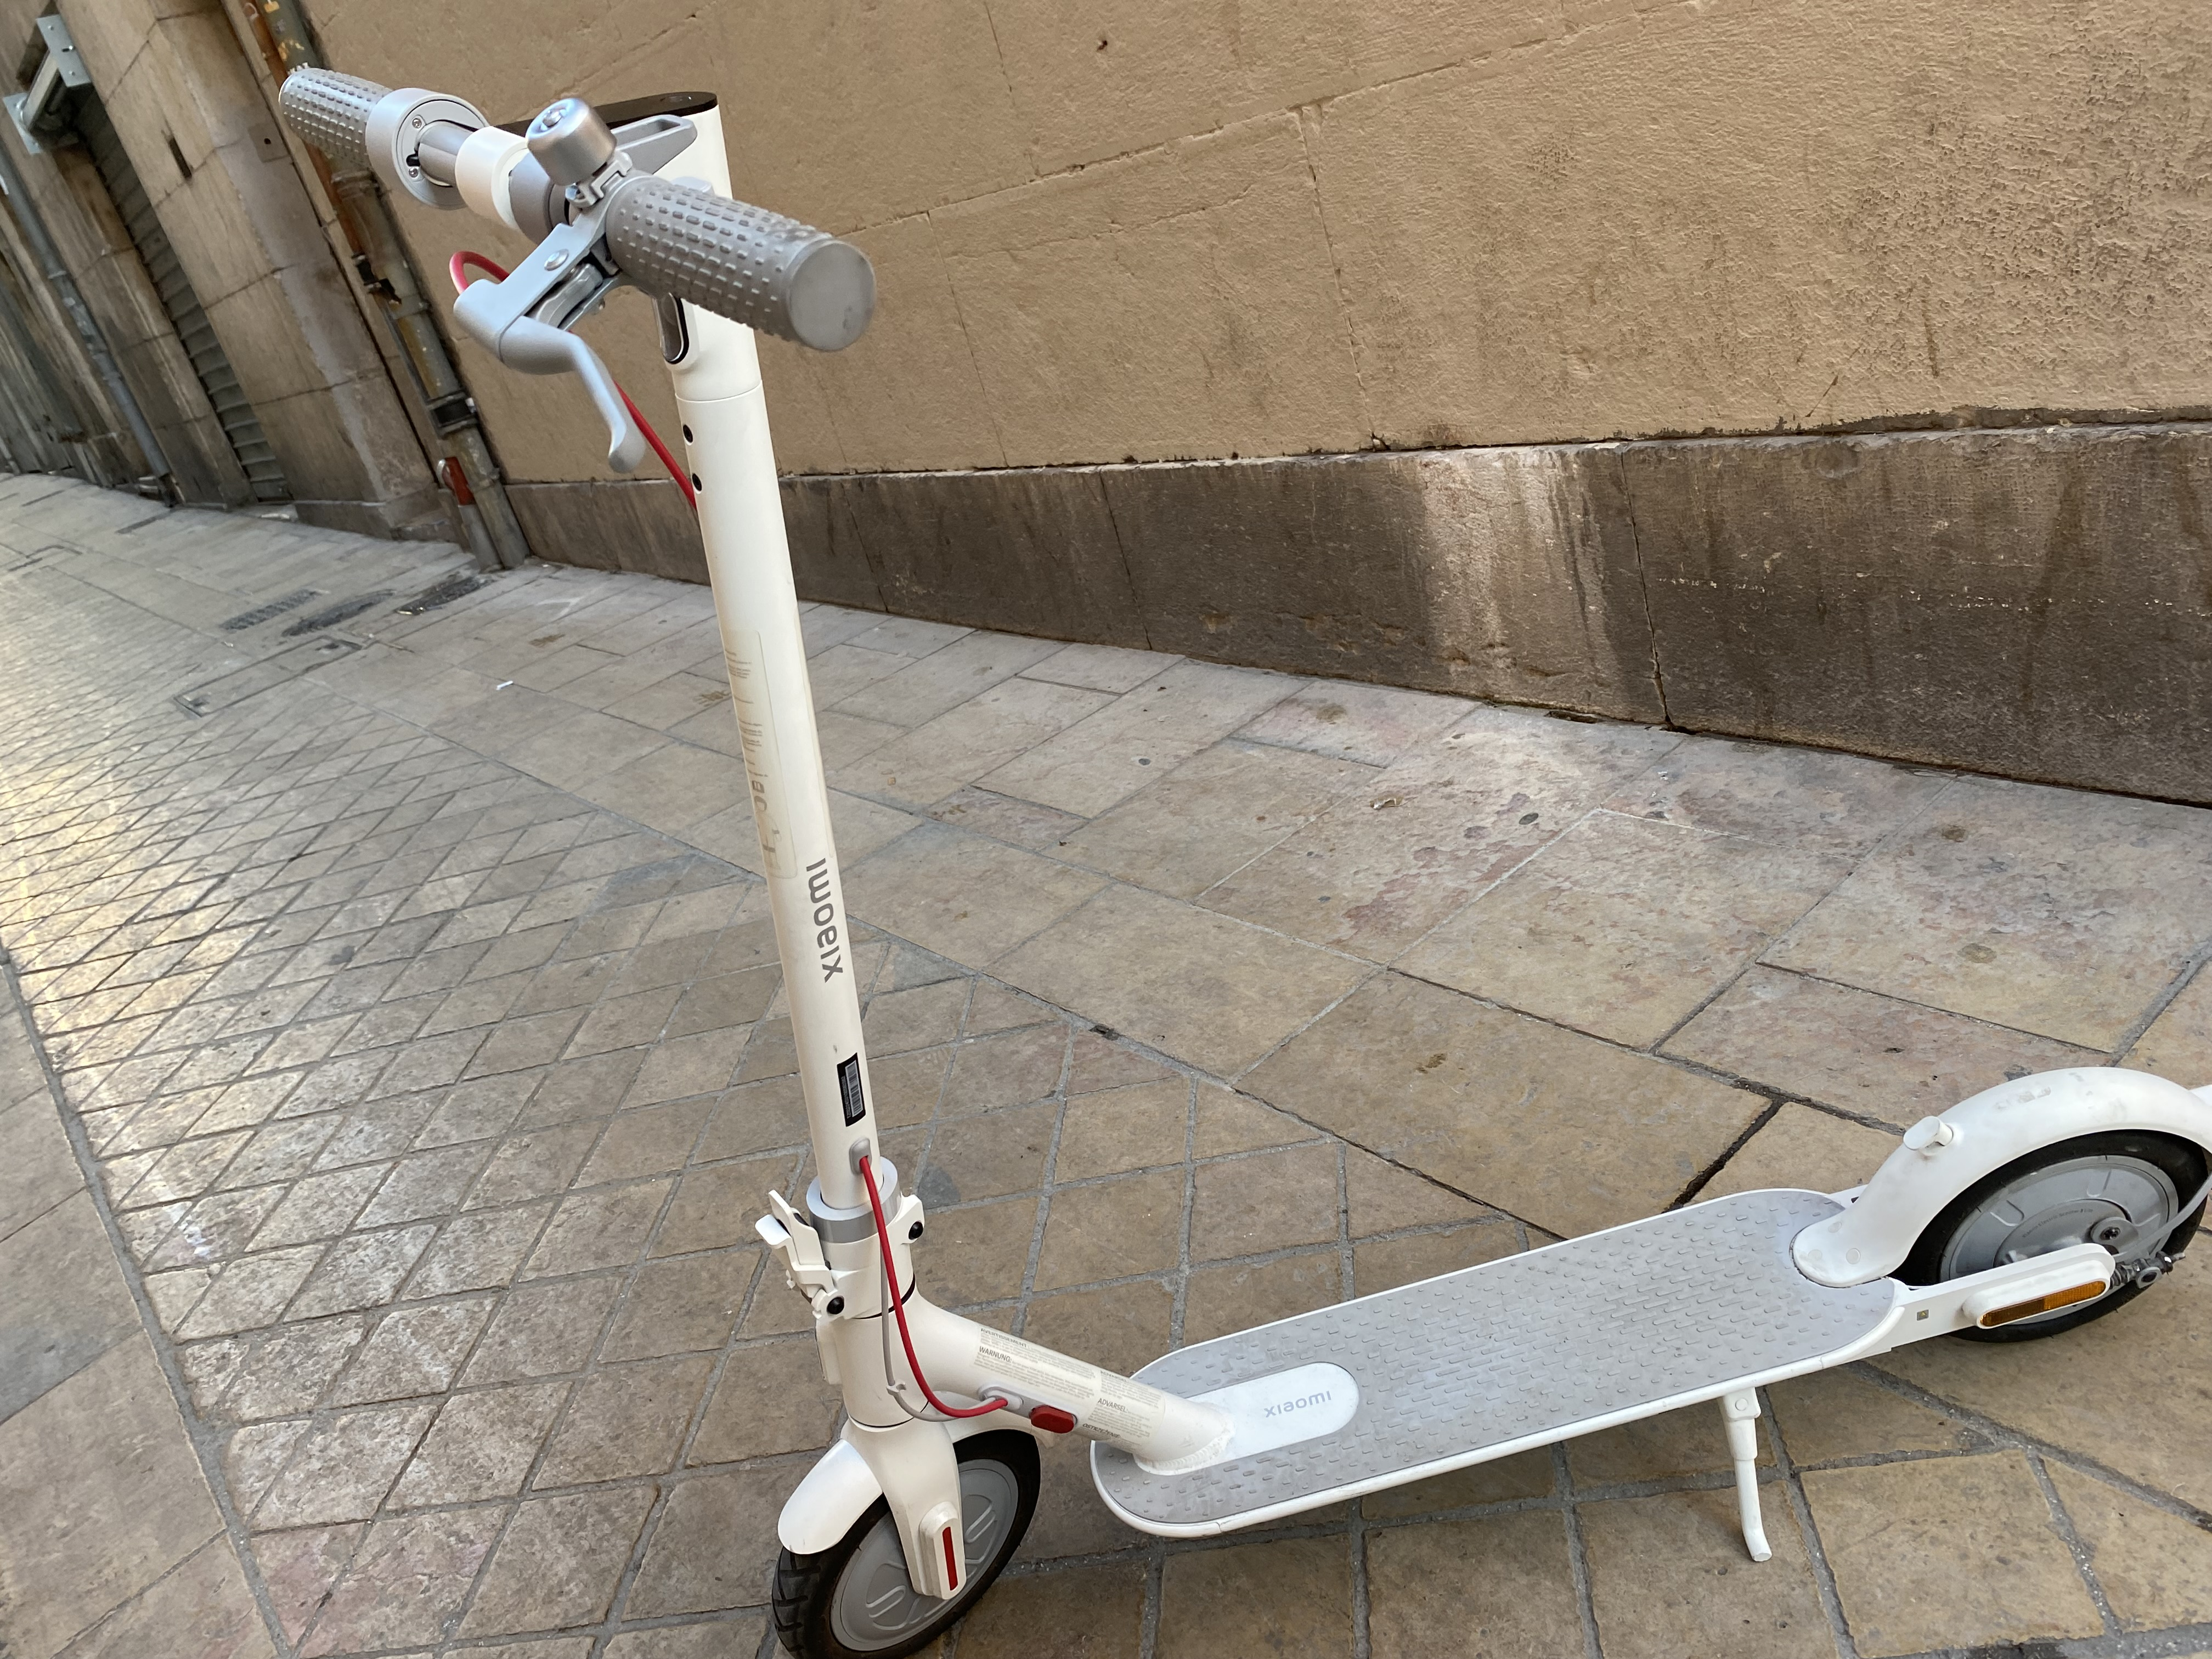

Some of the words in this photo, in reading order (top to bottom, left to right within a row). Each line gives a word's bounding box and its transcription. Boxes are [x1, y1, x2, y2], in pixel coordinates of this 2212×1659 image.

[806, 857, 843, 983] xiaomi
[979, 1346, 1012, 1363] WARNUNG:
[1263, 1391, 1331, 1418] xiaomi
